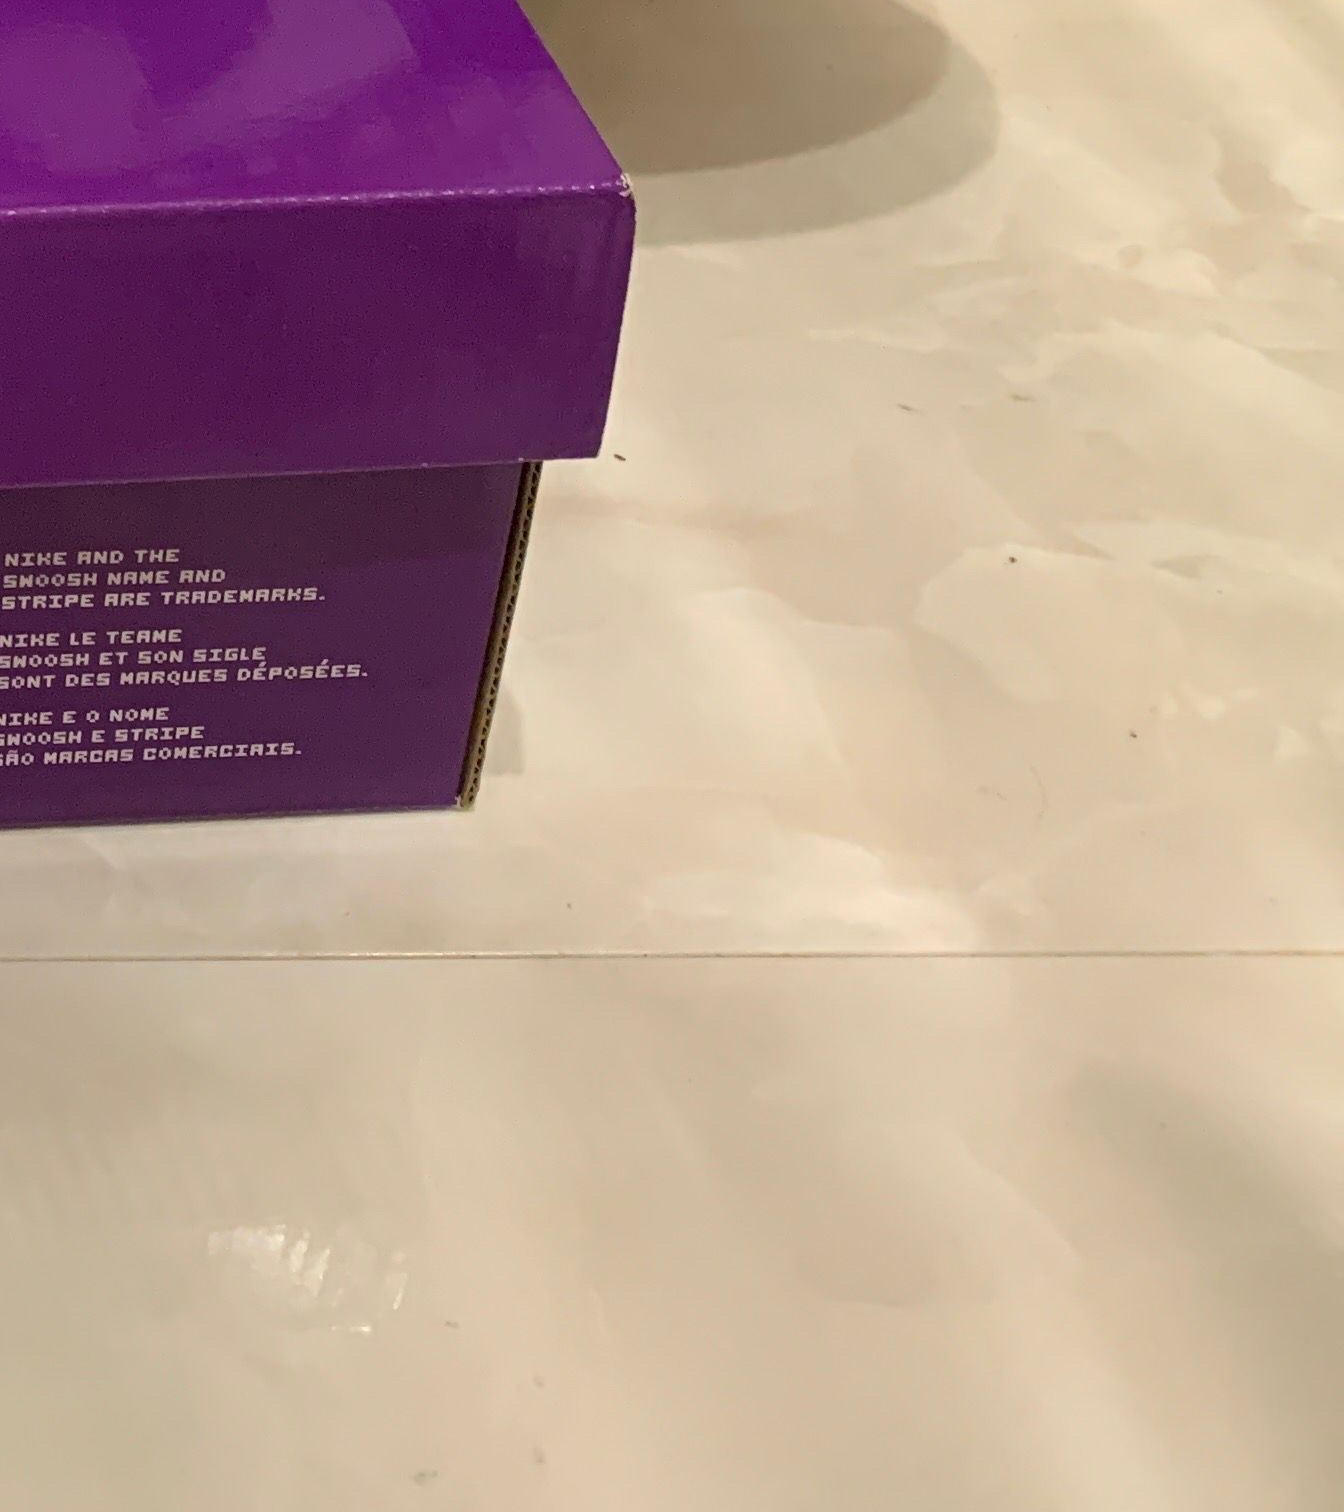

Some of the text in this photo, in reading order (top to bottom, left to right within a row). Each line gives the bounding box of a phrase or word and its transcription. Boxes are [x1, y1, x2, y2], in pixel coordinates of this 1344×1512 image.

[4, 548, 181, 568] NIKE AND THE
[2, 568, 226, 589] SWOOSH NAME AND
[1, 586, 326, 611] STRIPE ARE TRADEMARKS.
[69, 631, 97, 646] LE
[98, 651, 129, 666] ET
[137, 649, 184, 665] SON
[192, 646, 267, 663] SIGLE
[64, 672, 111, 688] DES
[119, 668, 228, 686] MARQUES
[236, 658, 368, 682] DÉPOSÉES.
[62, 710, 77, 724] E
[85, 709, 101, 724] O
[109, 706, 170, 723] NOME
[90, 729, 106, 744] E
[114, 725, 205, 743] STRIPE
[43, 748, 134, 765] MARCAS
[142, 742, 302, 761] COMERCIAIS.
